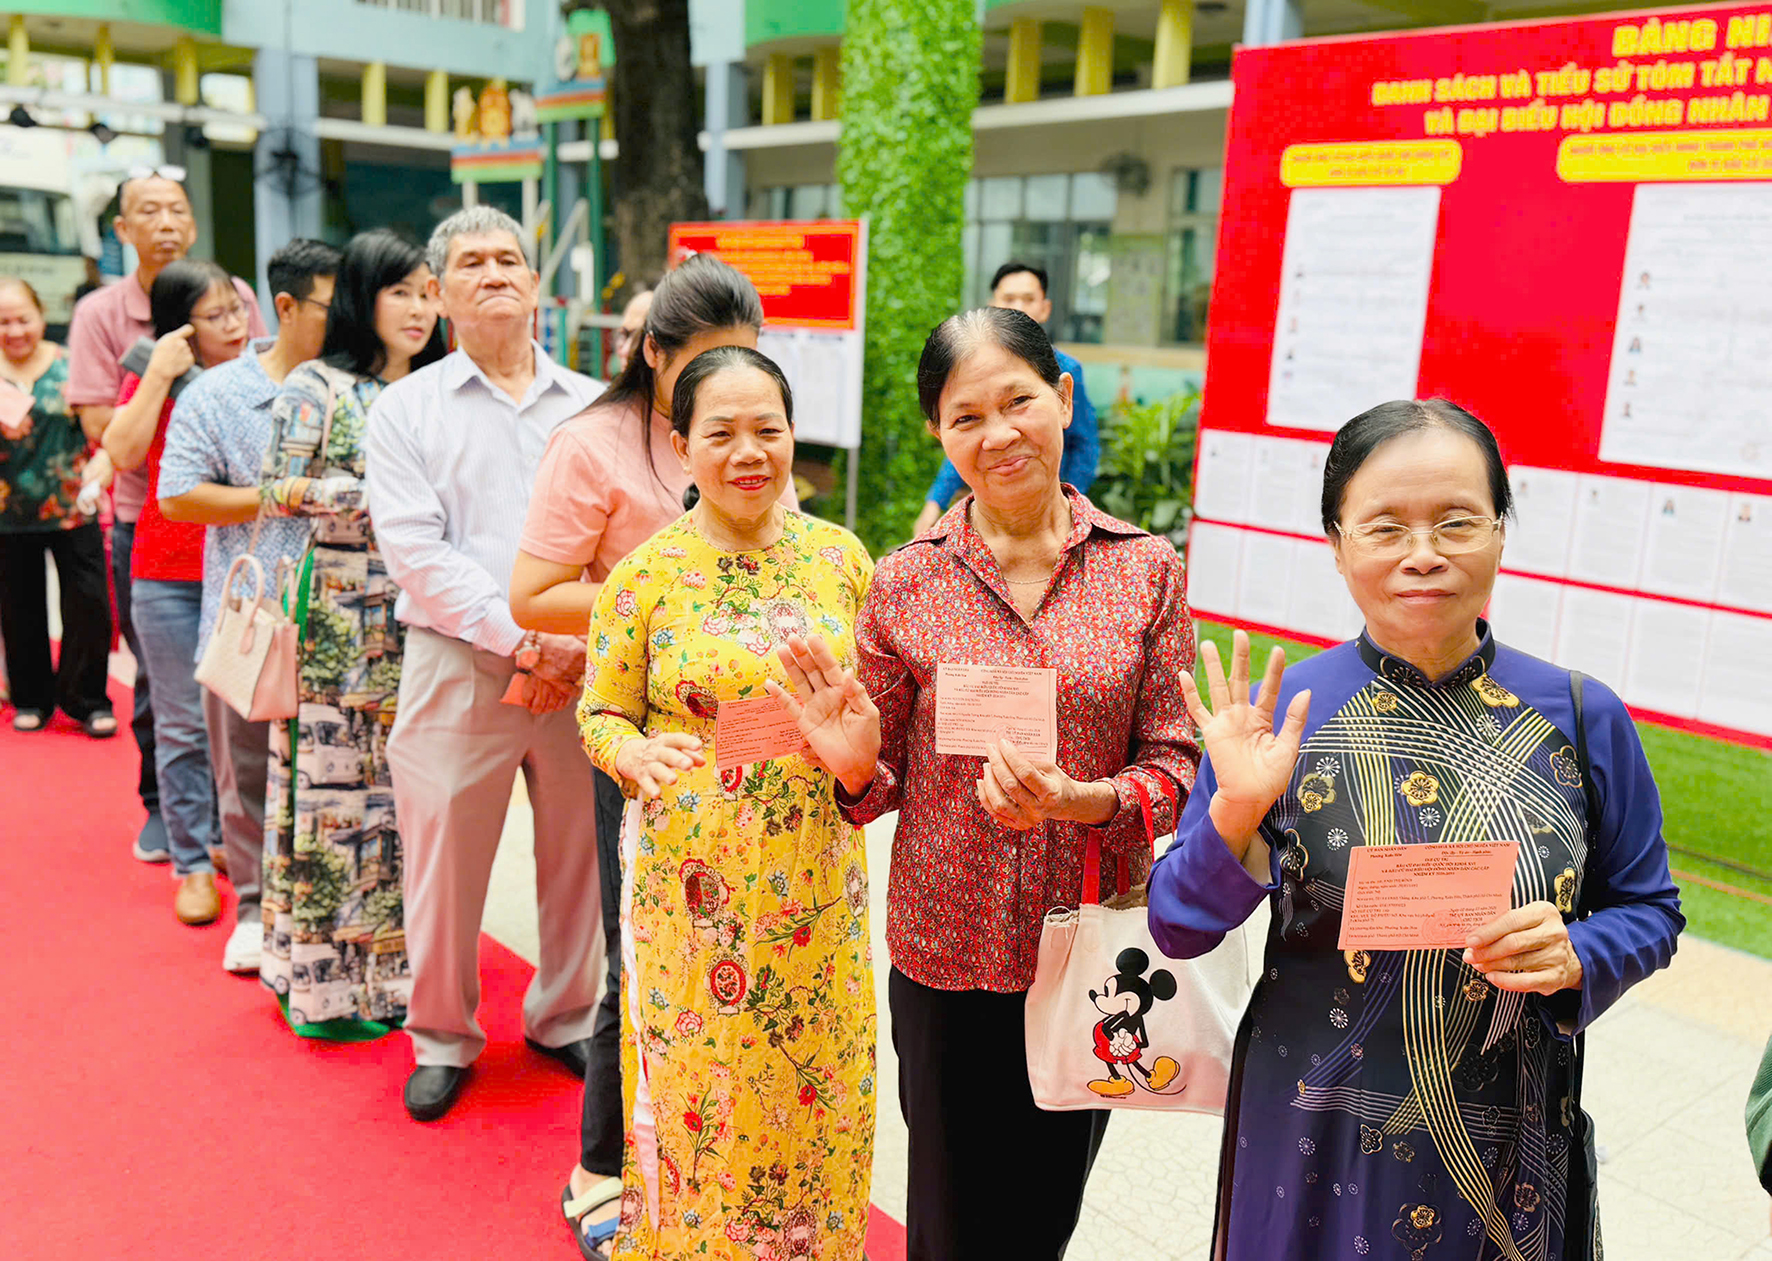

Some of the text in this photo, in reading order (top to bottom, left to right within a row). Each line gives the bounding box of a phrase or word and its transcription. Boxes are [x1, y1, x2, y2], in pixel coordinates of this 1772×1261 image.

[1434, 72, 1498, 102] SÁCH
[1635, 59, 1695, 91] TÓM
[1686, 91, 1771, 123] NHÂN
